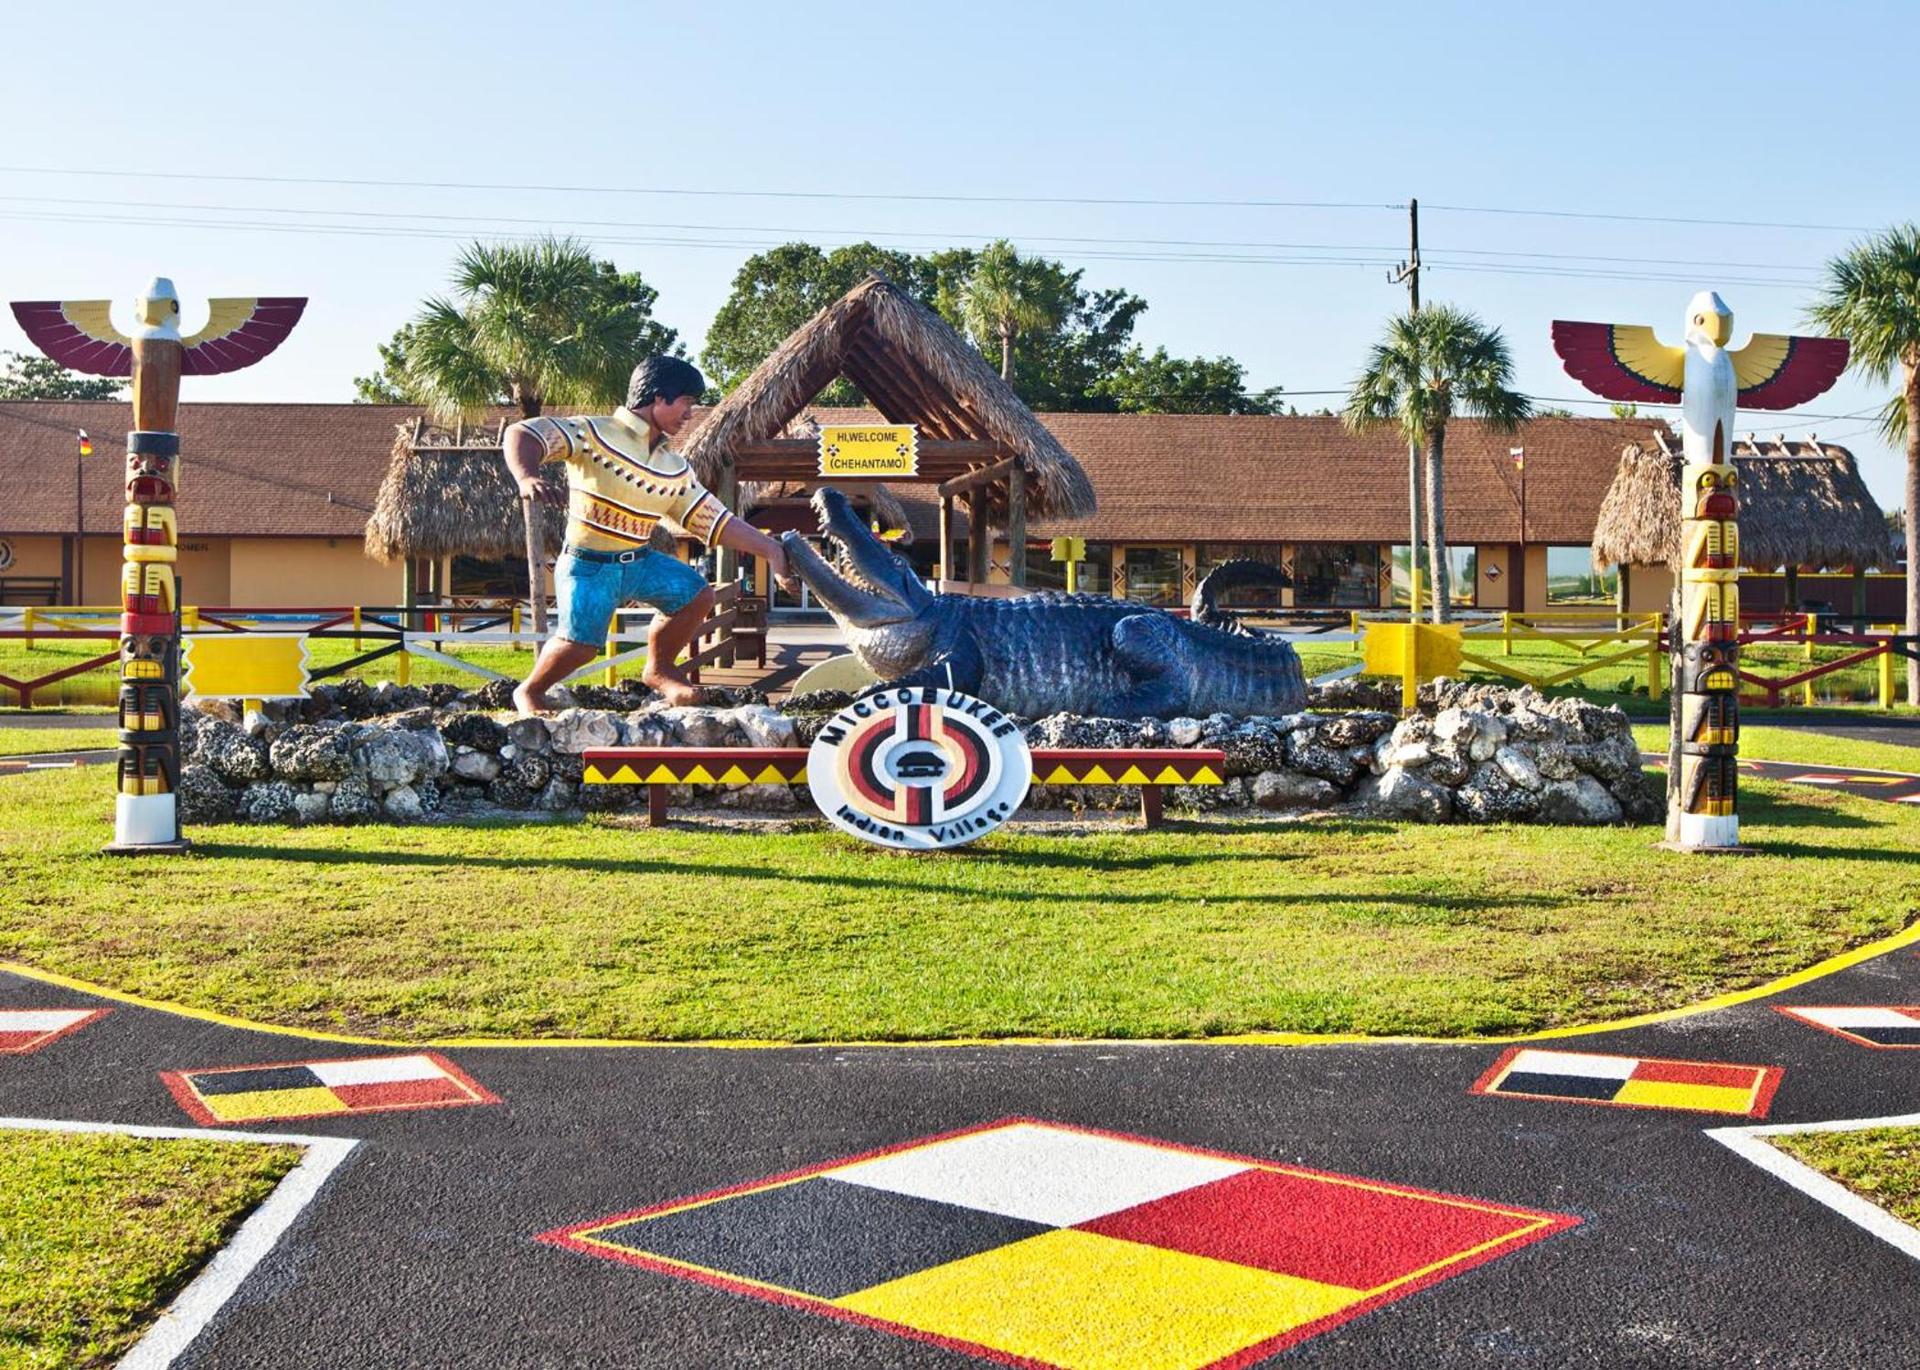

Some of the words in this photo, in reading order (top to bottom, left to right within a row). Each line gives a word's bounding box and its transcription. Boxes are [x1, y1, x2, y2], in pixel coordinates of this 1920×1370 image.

[177, 543, 208, 552] OMEN
[836, 804, 904, 842] Indian
[928, 801, 1009, 842] Village
